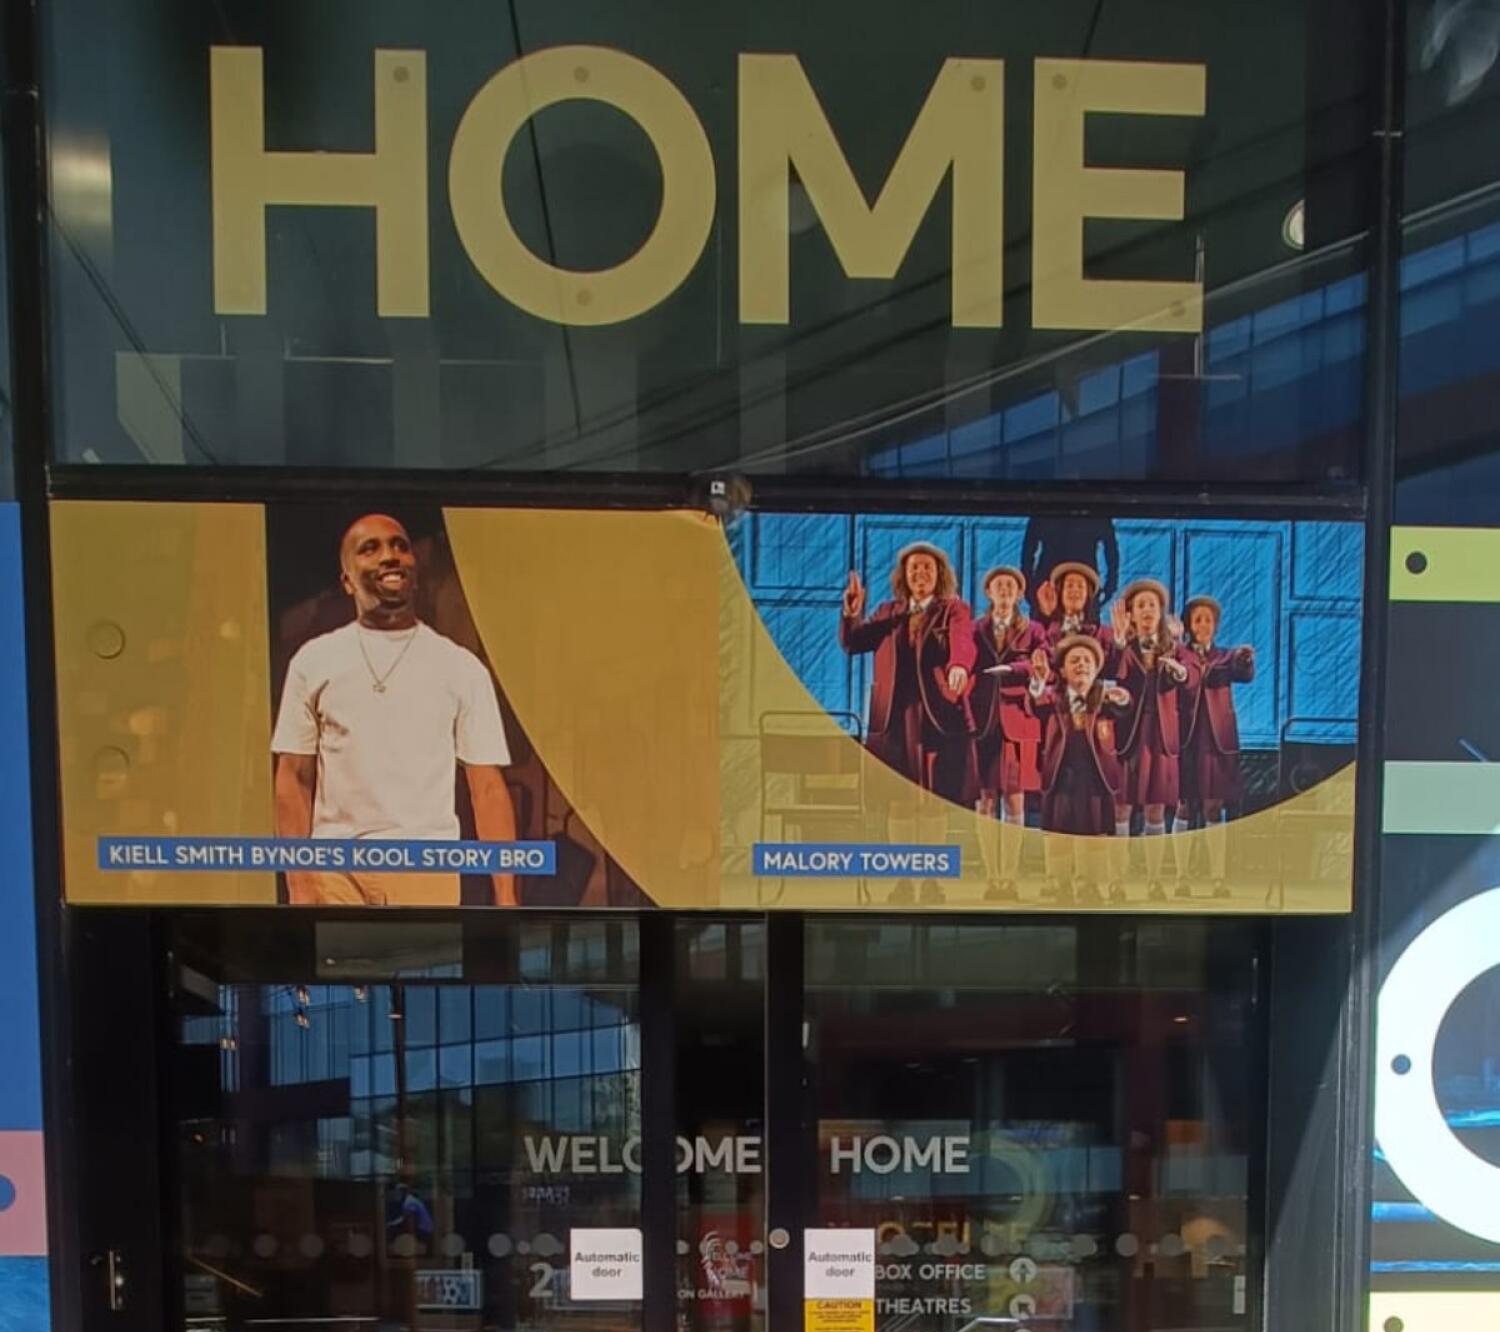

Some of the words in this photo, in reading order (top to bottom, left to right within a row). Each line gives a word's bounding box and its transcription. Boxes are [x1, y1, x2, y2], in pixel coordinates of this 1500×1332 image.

[210, 44, 1206, 333] HOME
[110, 845, 168, 865] KIELL
[175, 845, 243, 865] SMITH
[251, 846, 345, 866] BYNOE'S
[352, 847, 415, 867] KOOL
[423, 848, 491, 867] STORY
[500, 849, 544, 869] BRO
[763, 851, 853, 870] MALORY
[860, 852, 949, 872] TOWERS
[830, 1135, 970, 1174] HOME
[574, 1251, 640, 1263] Automatic
[808, 1251, 872, 1263] Automatic
[529, 1261, 552, 1298] 2
[592, 1266, 622, 1278] door
[826, 1266, 855, 1278] door
[875, 1264, 912, 1280] BOX
[919, 1264, 986, 1280] OFFICE
[877, 1298, 971, 1314] THEATRES
